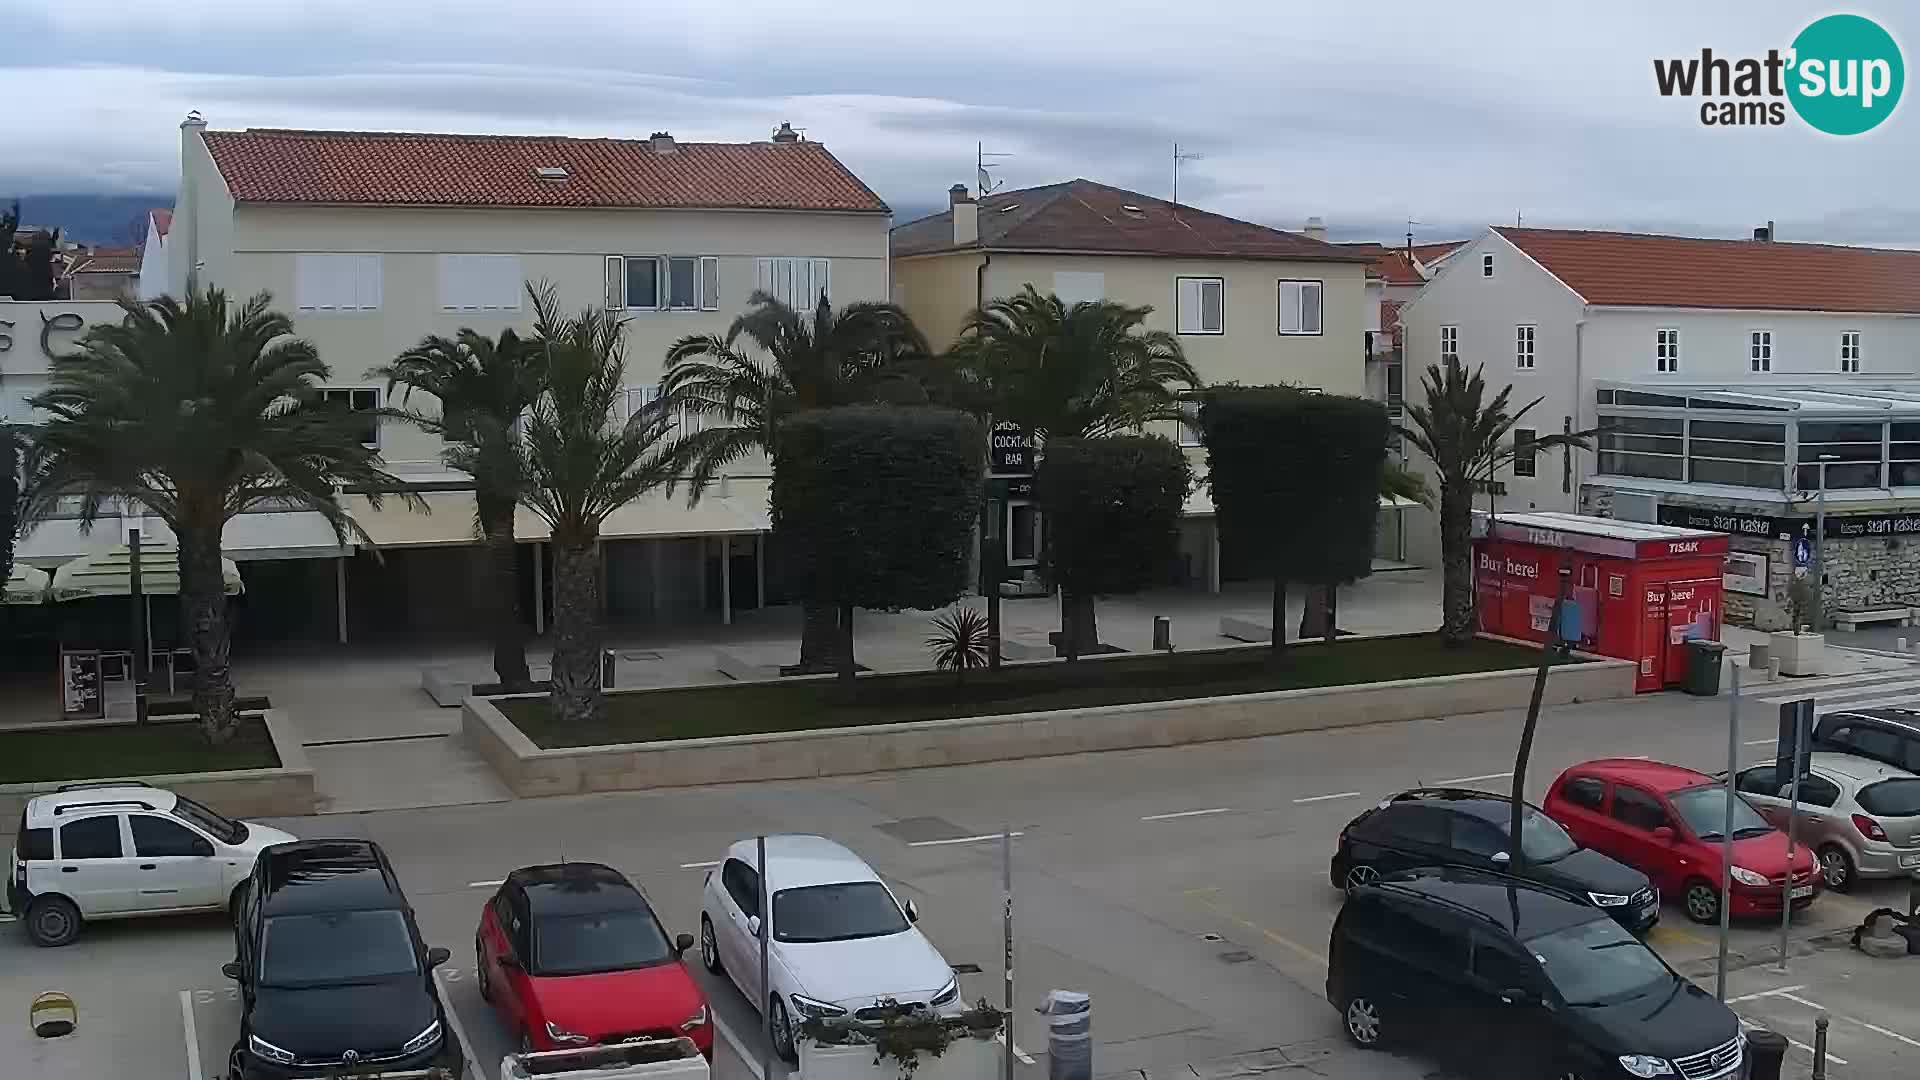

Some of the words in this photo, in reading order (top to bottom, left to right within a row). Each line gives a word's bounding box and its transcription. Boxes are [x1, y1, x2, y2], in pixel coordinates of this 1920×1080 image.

[994, 435, 1034, 449] COCKTAIL
[1005, 453, 1022, 465] BAR
[1668, 542, 1700, 553] TISAK
[1506, 556, 1539, 579] here!
[1647, 591, 1666, 604] Buy
[1670, 588, 1695, 601] here!
